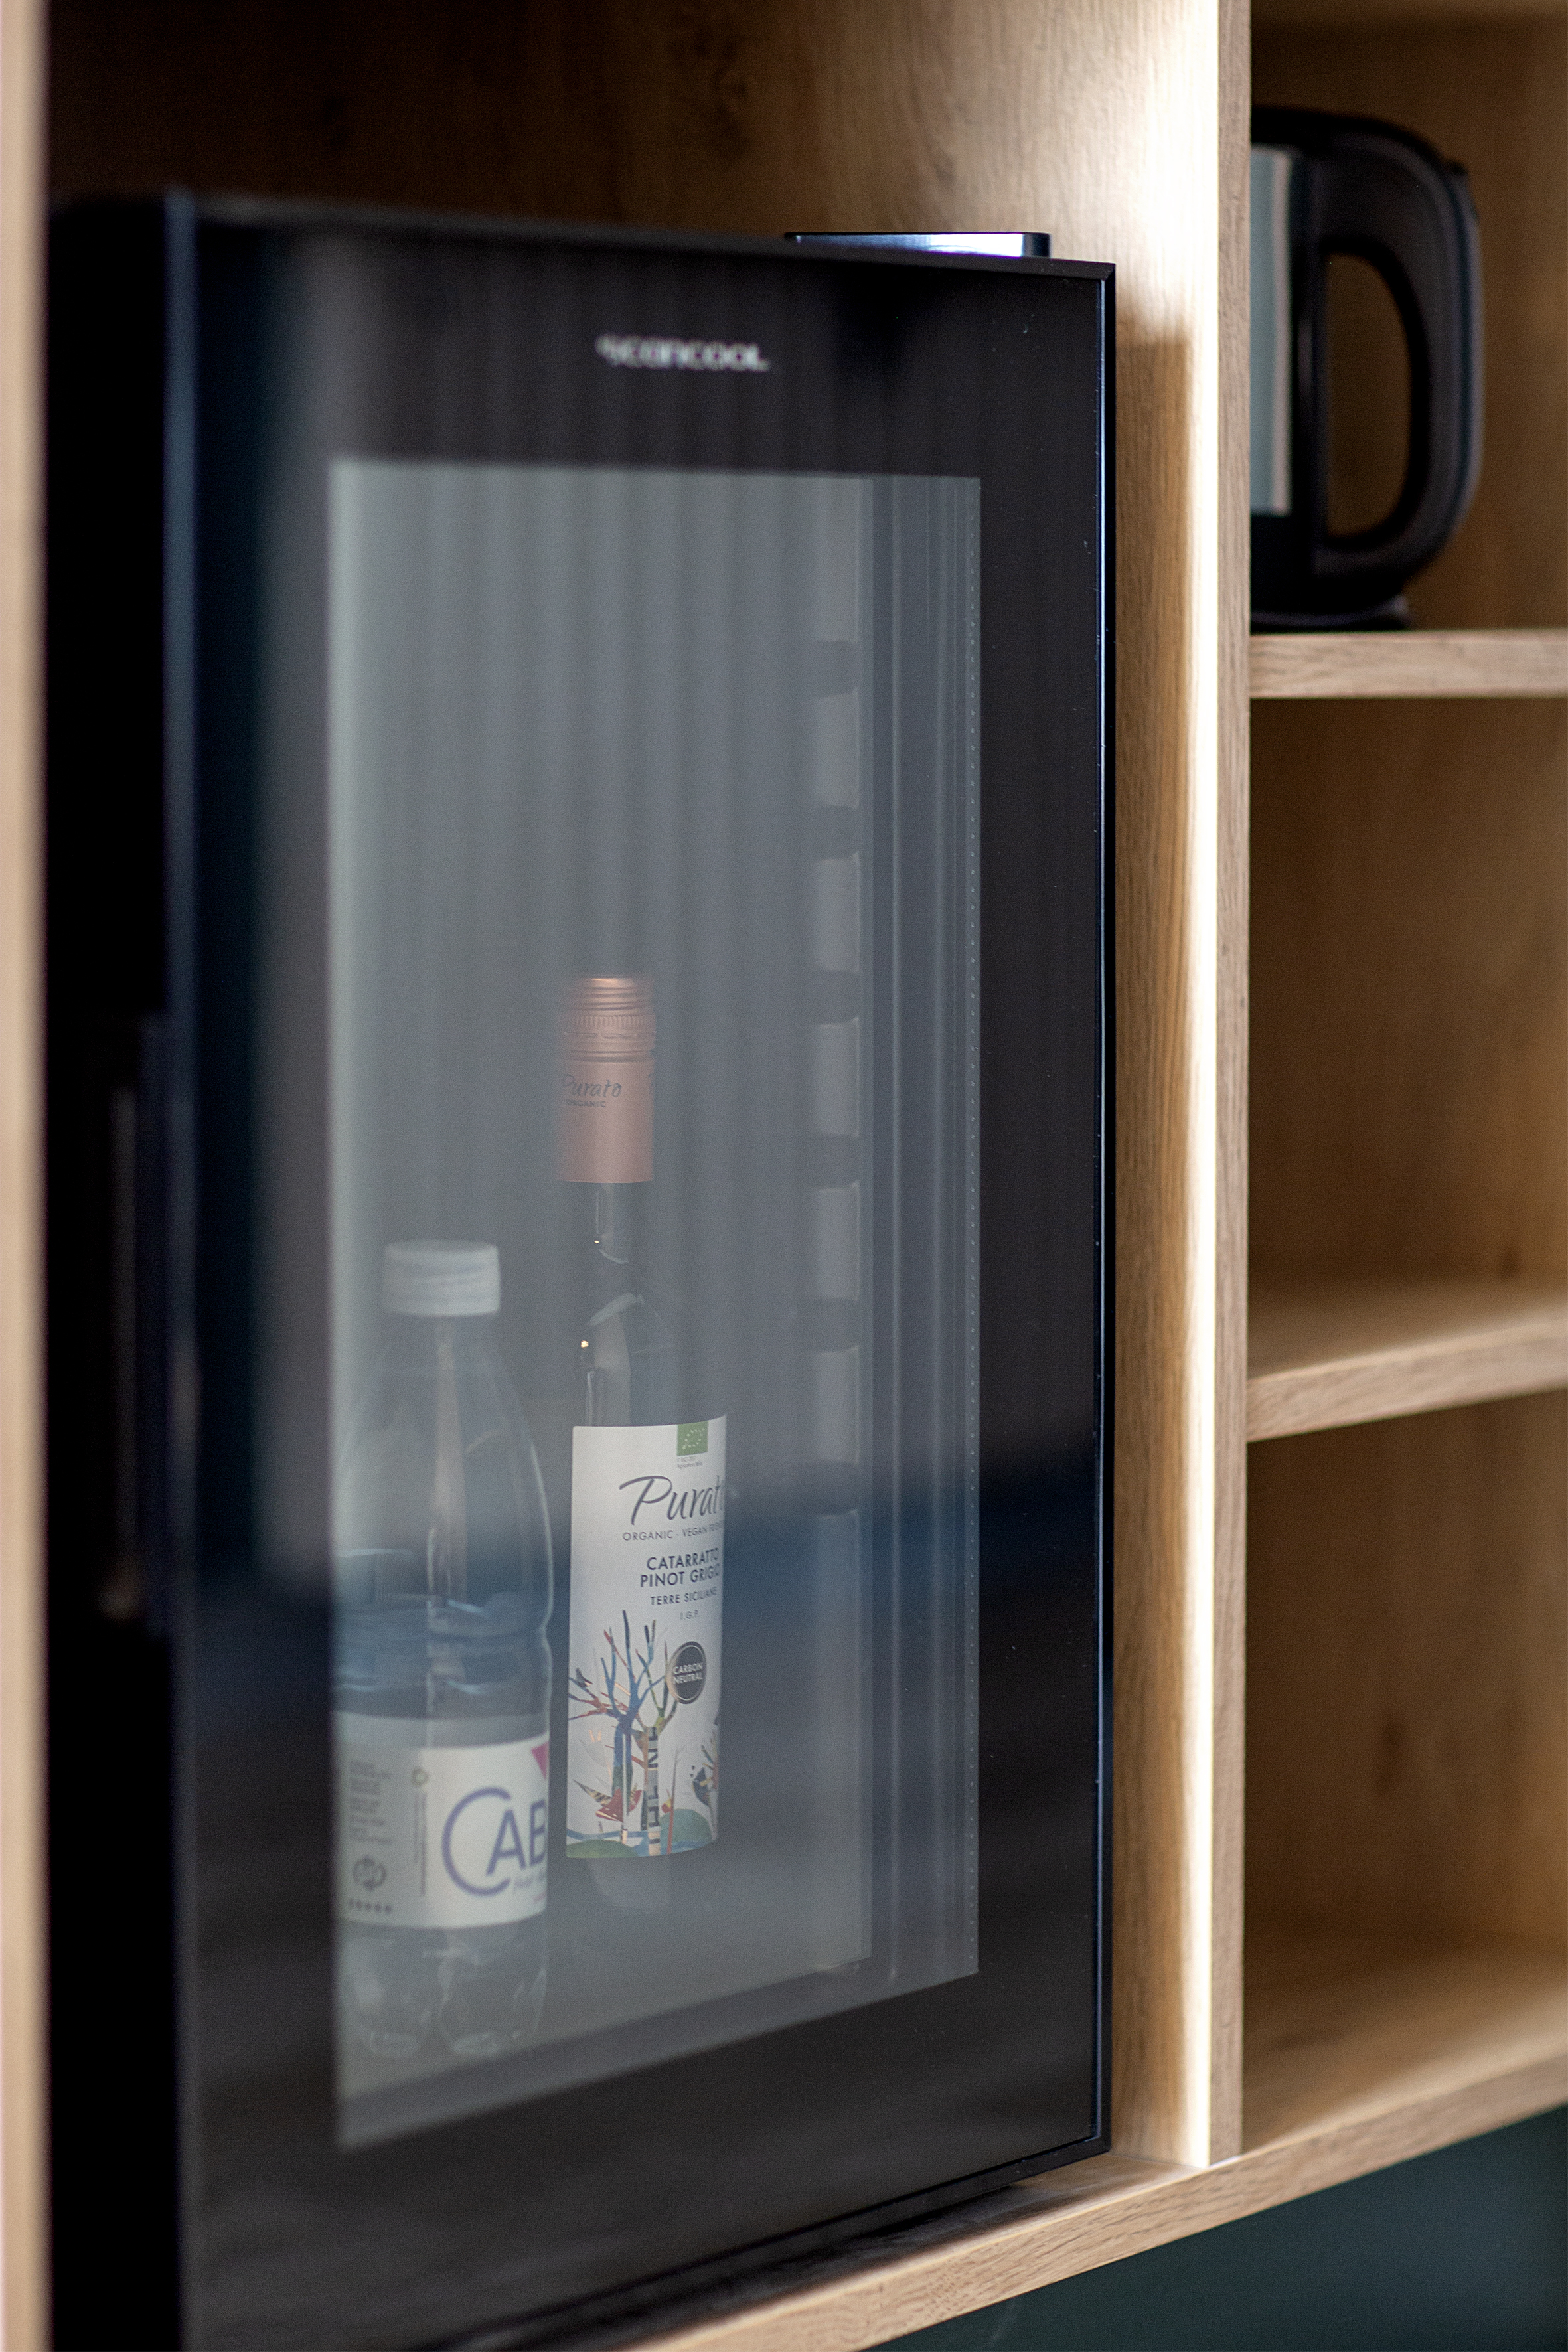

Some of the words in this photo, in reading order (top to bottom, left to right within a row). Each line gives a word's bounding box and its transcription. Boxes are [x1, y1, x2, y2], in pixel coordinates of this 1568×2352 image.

[623, 1529, 673, 1541] ORGANIC
[681, 1526, 708, 1537] VEGAN
[640, 1571, 685, 1587] PINOT
[650, 1593, 680, 1605] TERRE
[672, 1662, 704, 1674] CARBON
[673, 1672, 704, 1684] NEUTRAL
